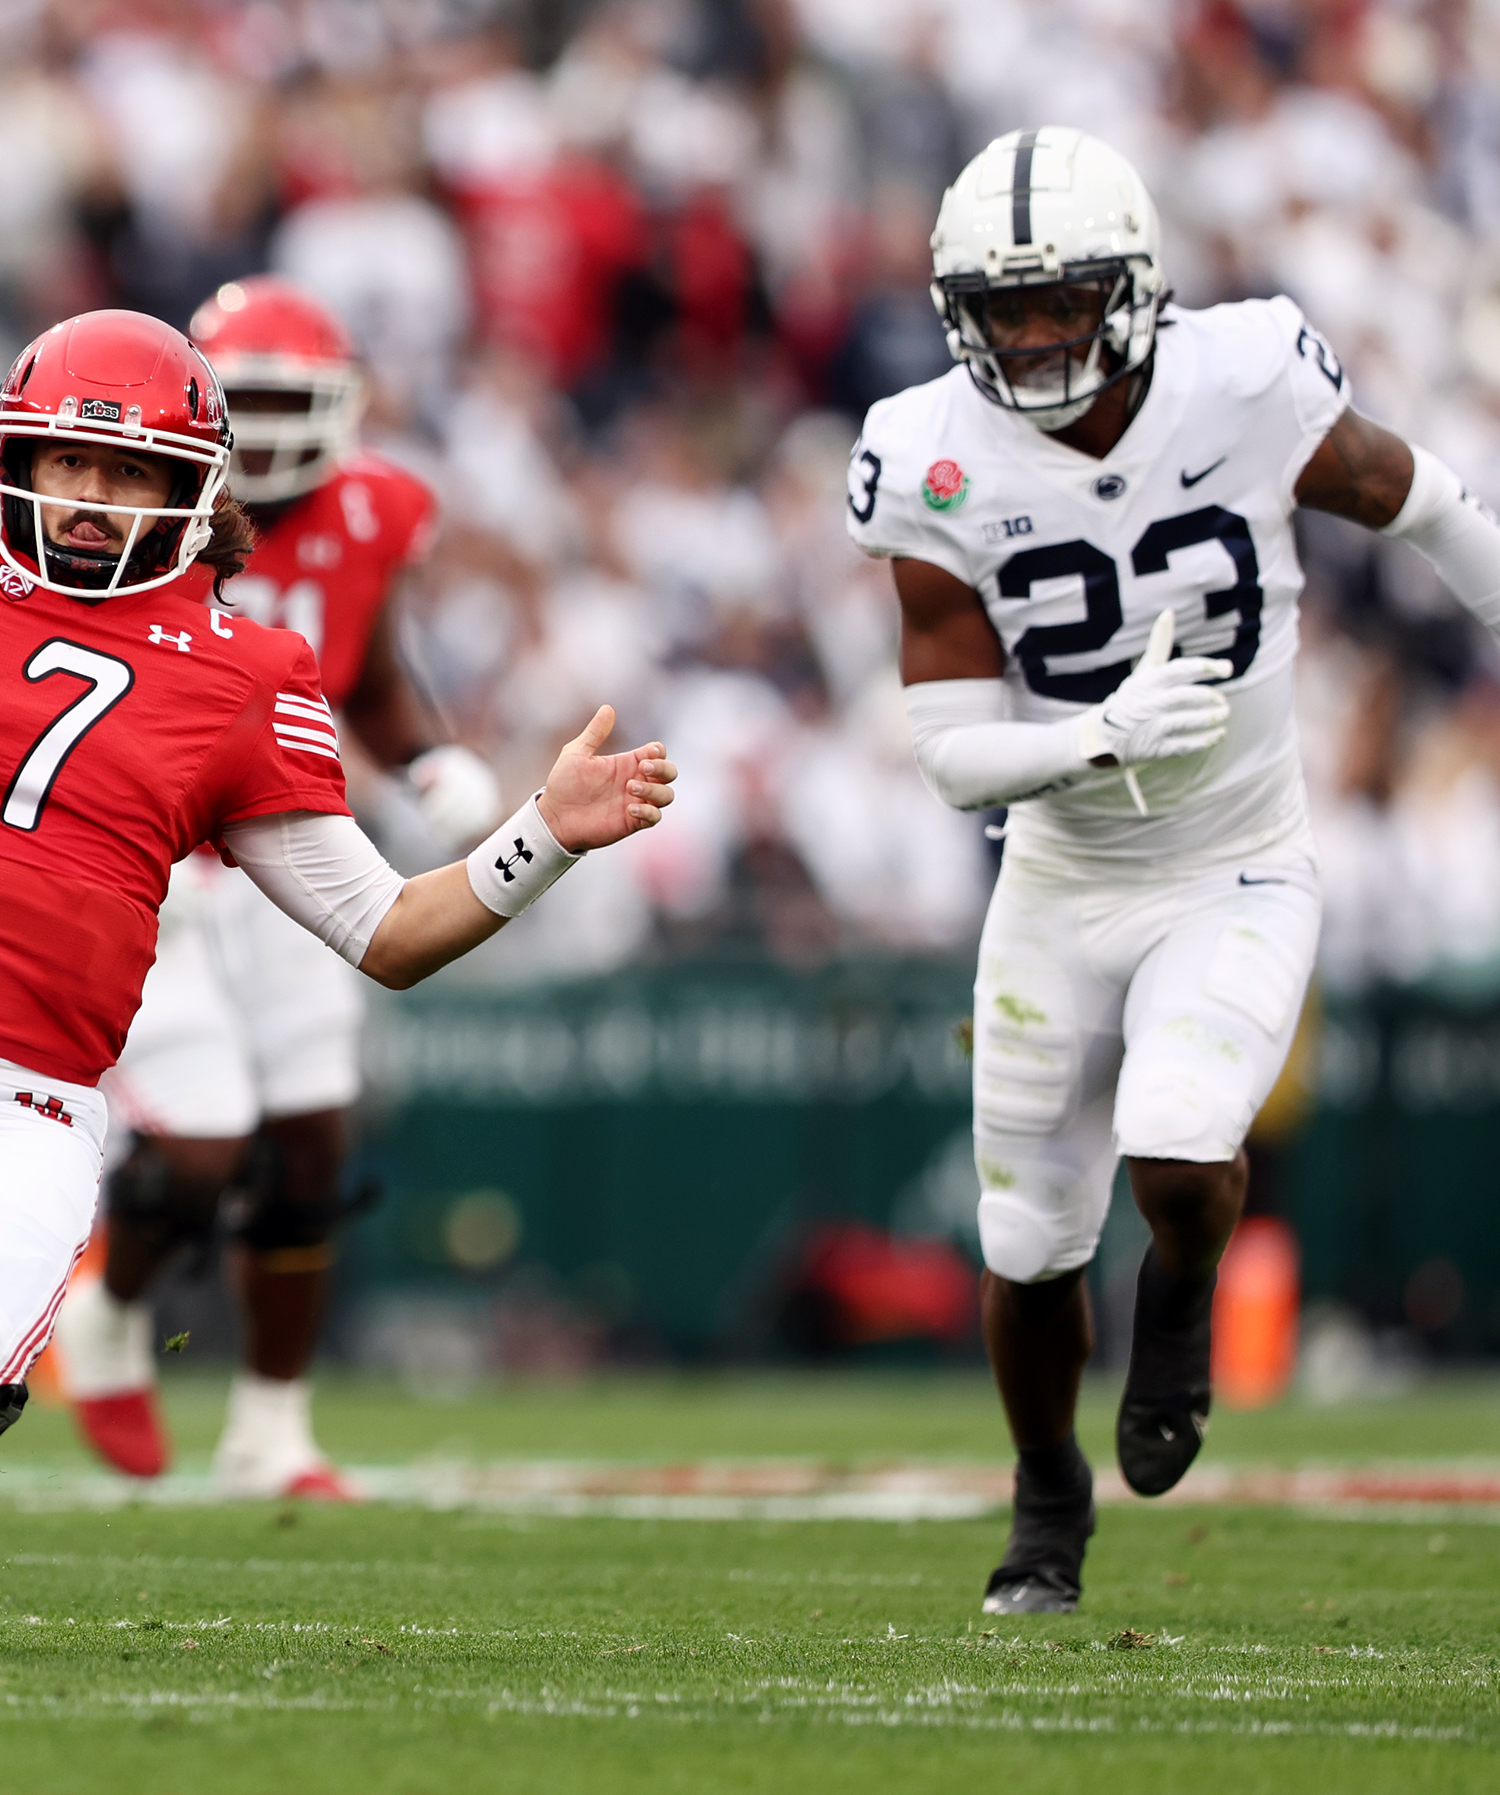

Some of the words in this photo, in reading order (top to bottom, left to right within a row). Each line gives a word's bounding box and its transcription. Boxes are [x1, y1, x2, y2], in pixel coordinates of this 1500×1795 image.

[210, 608, 234, 640] C
[996, 504, 1263, 704] 23
[0, 636, 135, 832] 7
